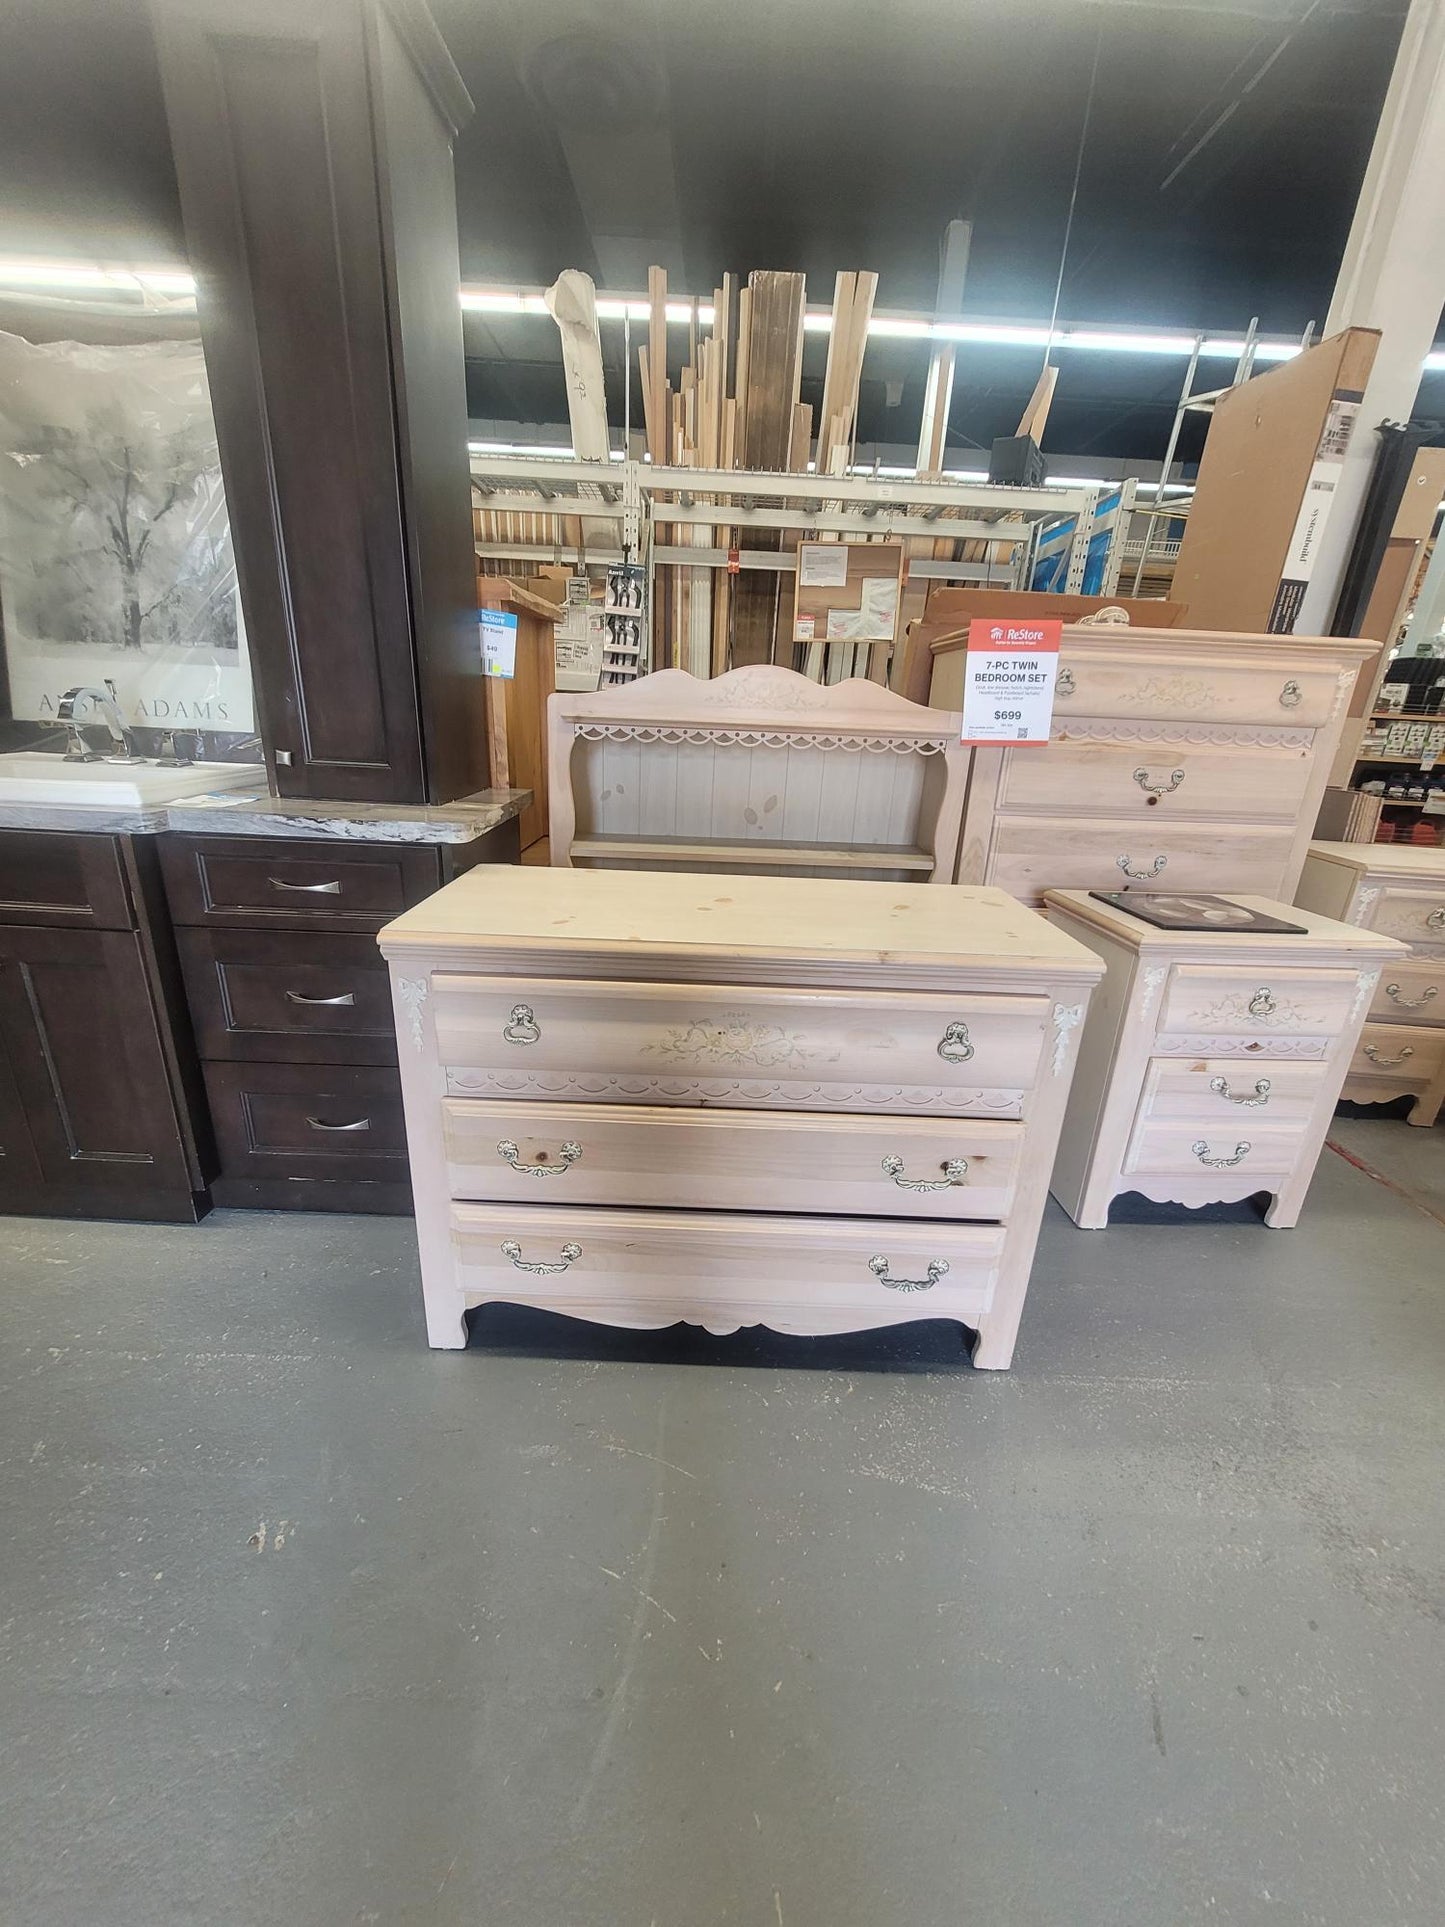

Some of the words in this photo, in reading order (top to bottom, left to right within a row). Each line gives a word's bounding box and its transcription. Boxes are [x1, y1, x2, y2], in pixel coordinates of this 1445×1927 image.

[1299, 508, 1319, 562] systembuild
[1007, 628, 1044, 640] ReStore
[986, 661, 1010, 670] 7-PC
[1011, 661, 1038, 670] TWIN
[975, 673, 1026, 683] BEDROOM
[1027, 673, 1048, 683] SET
[133, 698, 232, 720] ADAMS
[994, 710, 1022, 720] $699
